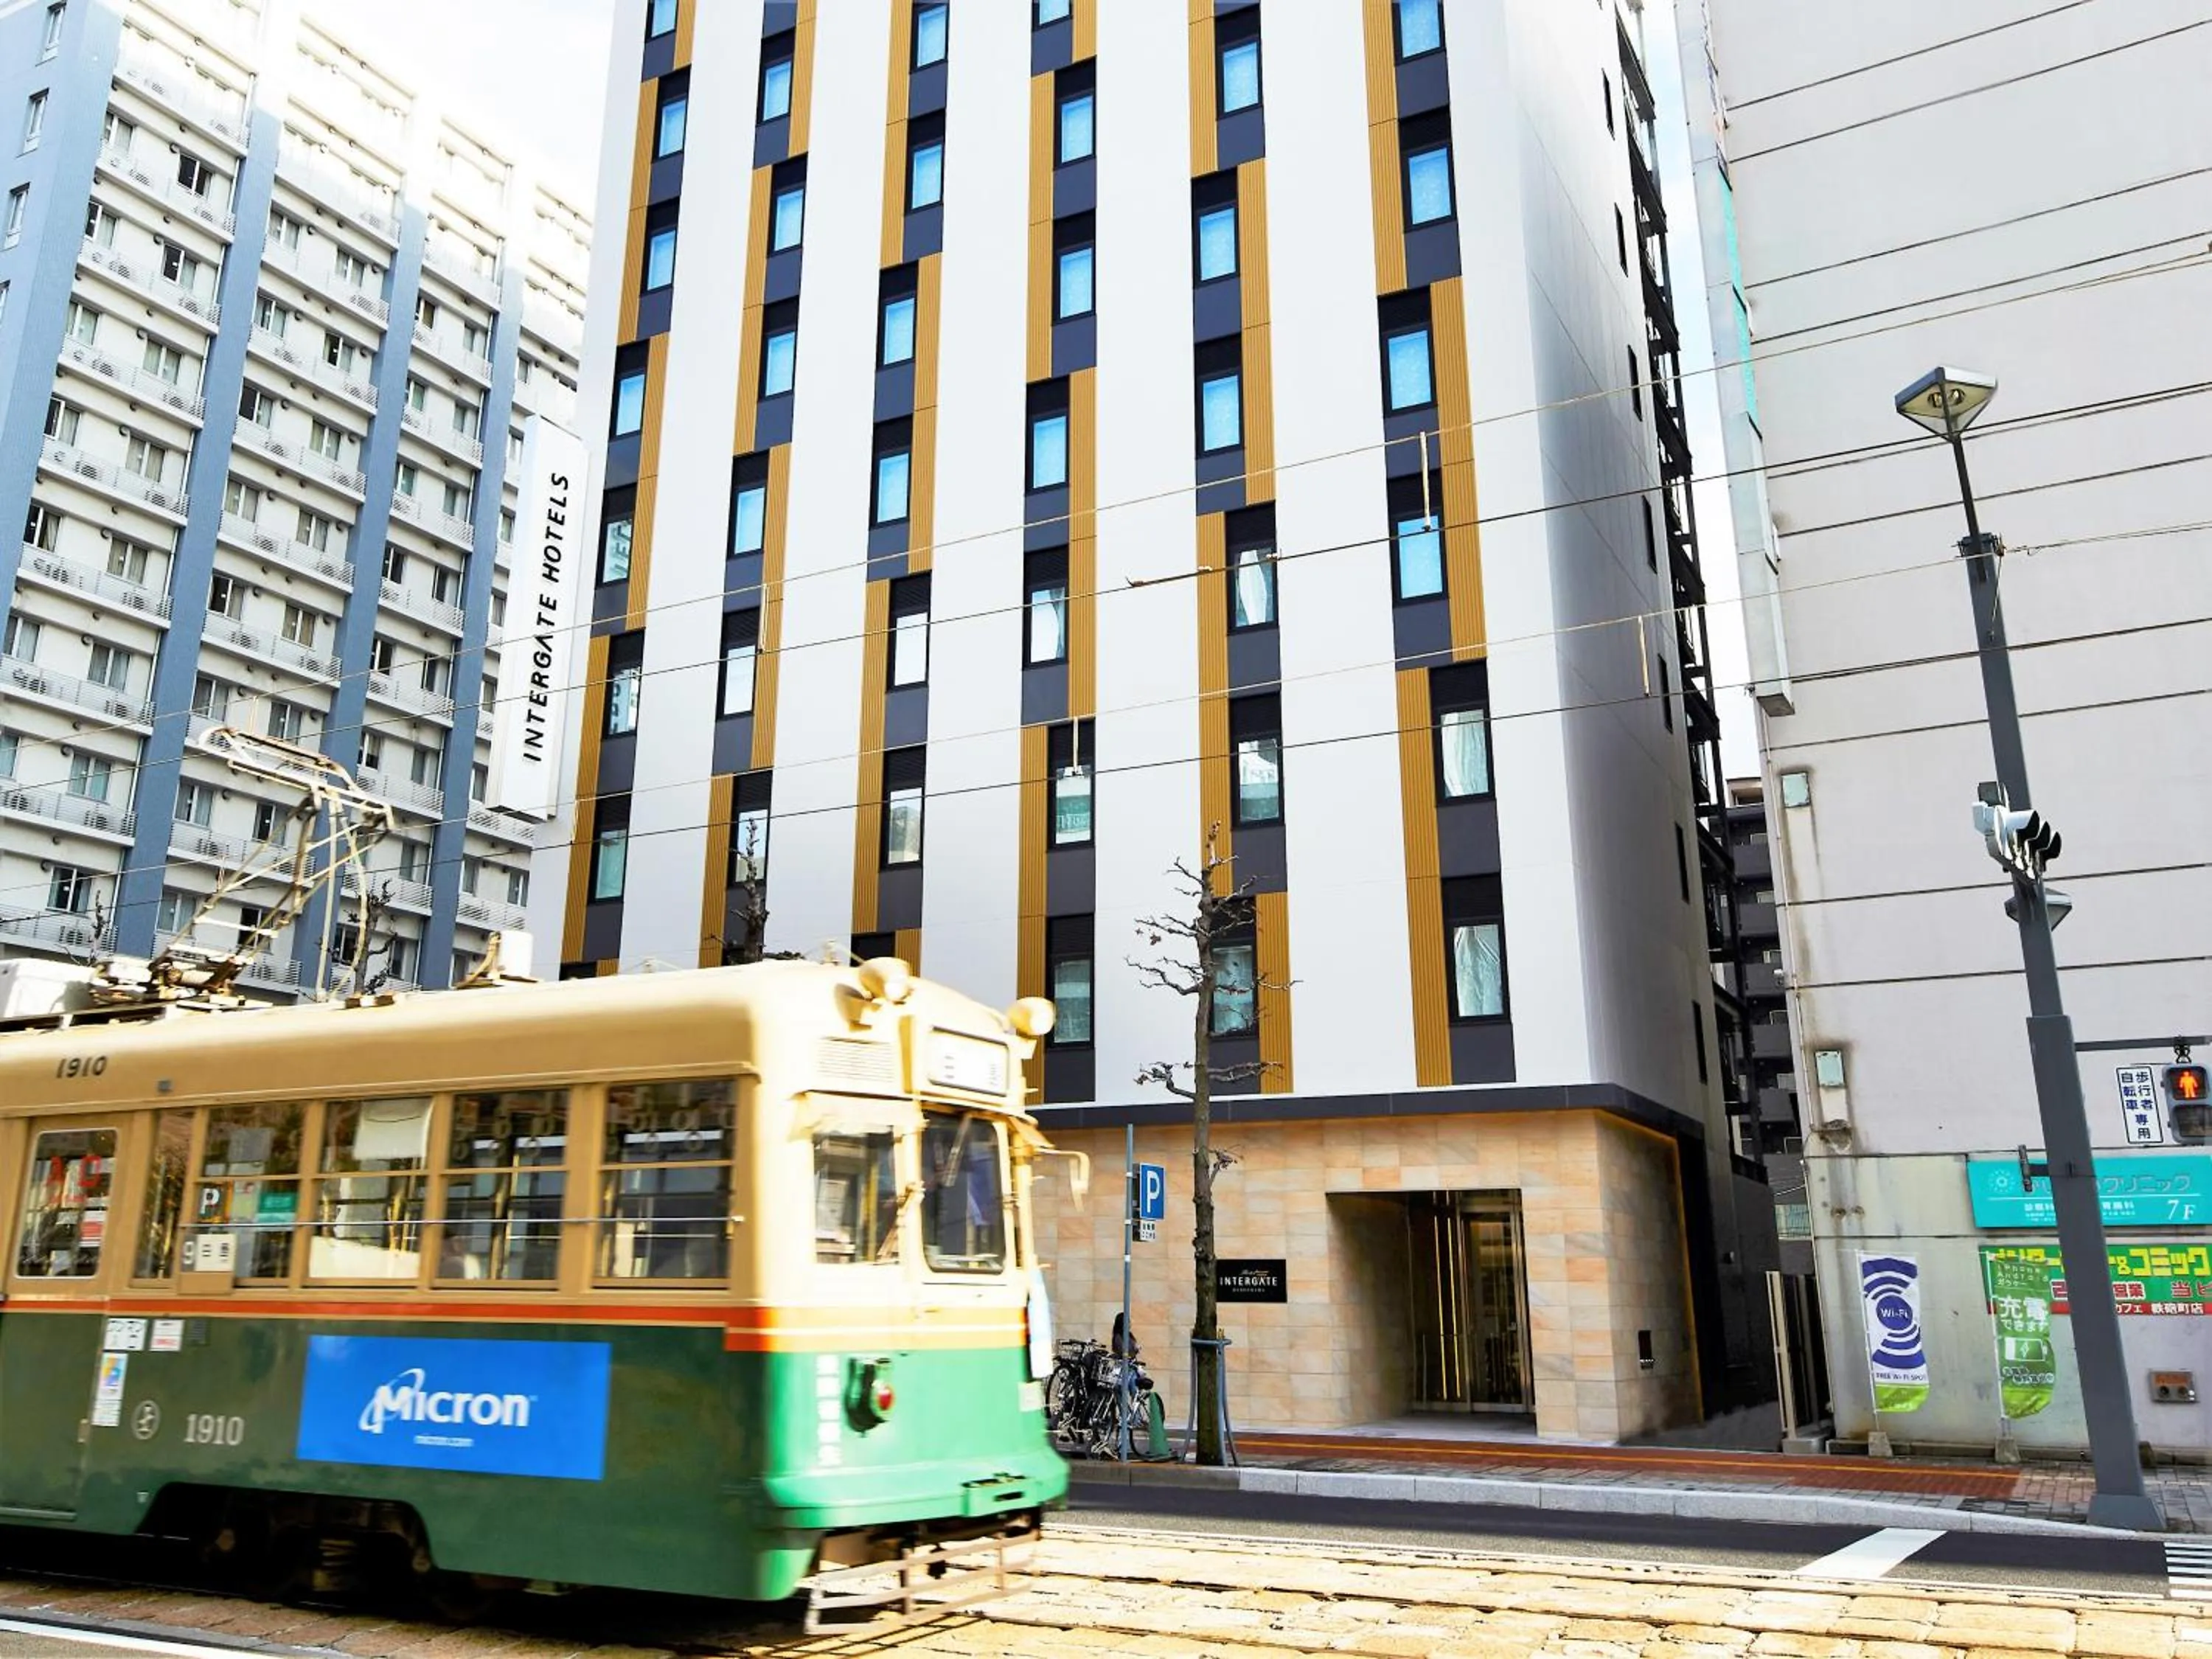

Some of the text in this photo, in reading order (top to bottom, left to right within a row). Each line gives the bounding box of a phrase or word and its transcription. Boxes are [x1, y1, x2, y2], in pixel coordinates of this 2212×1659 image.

[523, 473, 568, 762] INTERGATE HOTELS
[56, 1055, 108, 1079] 1910
[1147, 1170, 1160, 1213] P
[2167, 1200, 2196, 1220] 7F
[1220, 1276, 1277, 1286] INTERGATE
[1999, 1295, 2049, 1320] 充電
[184, 1413, 245, 1445] 1910
